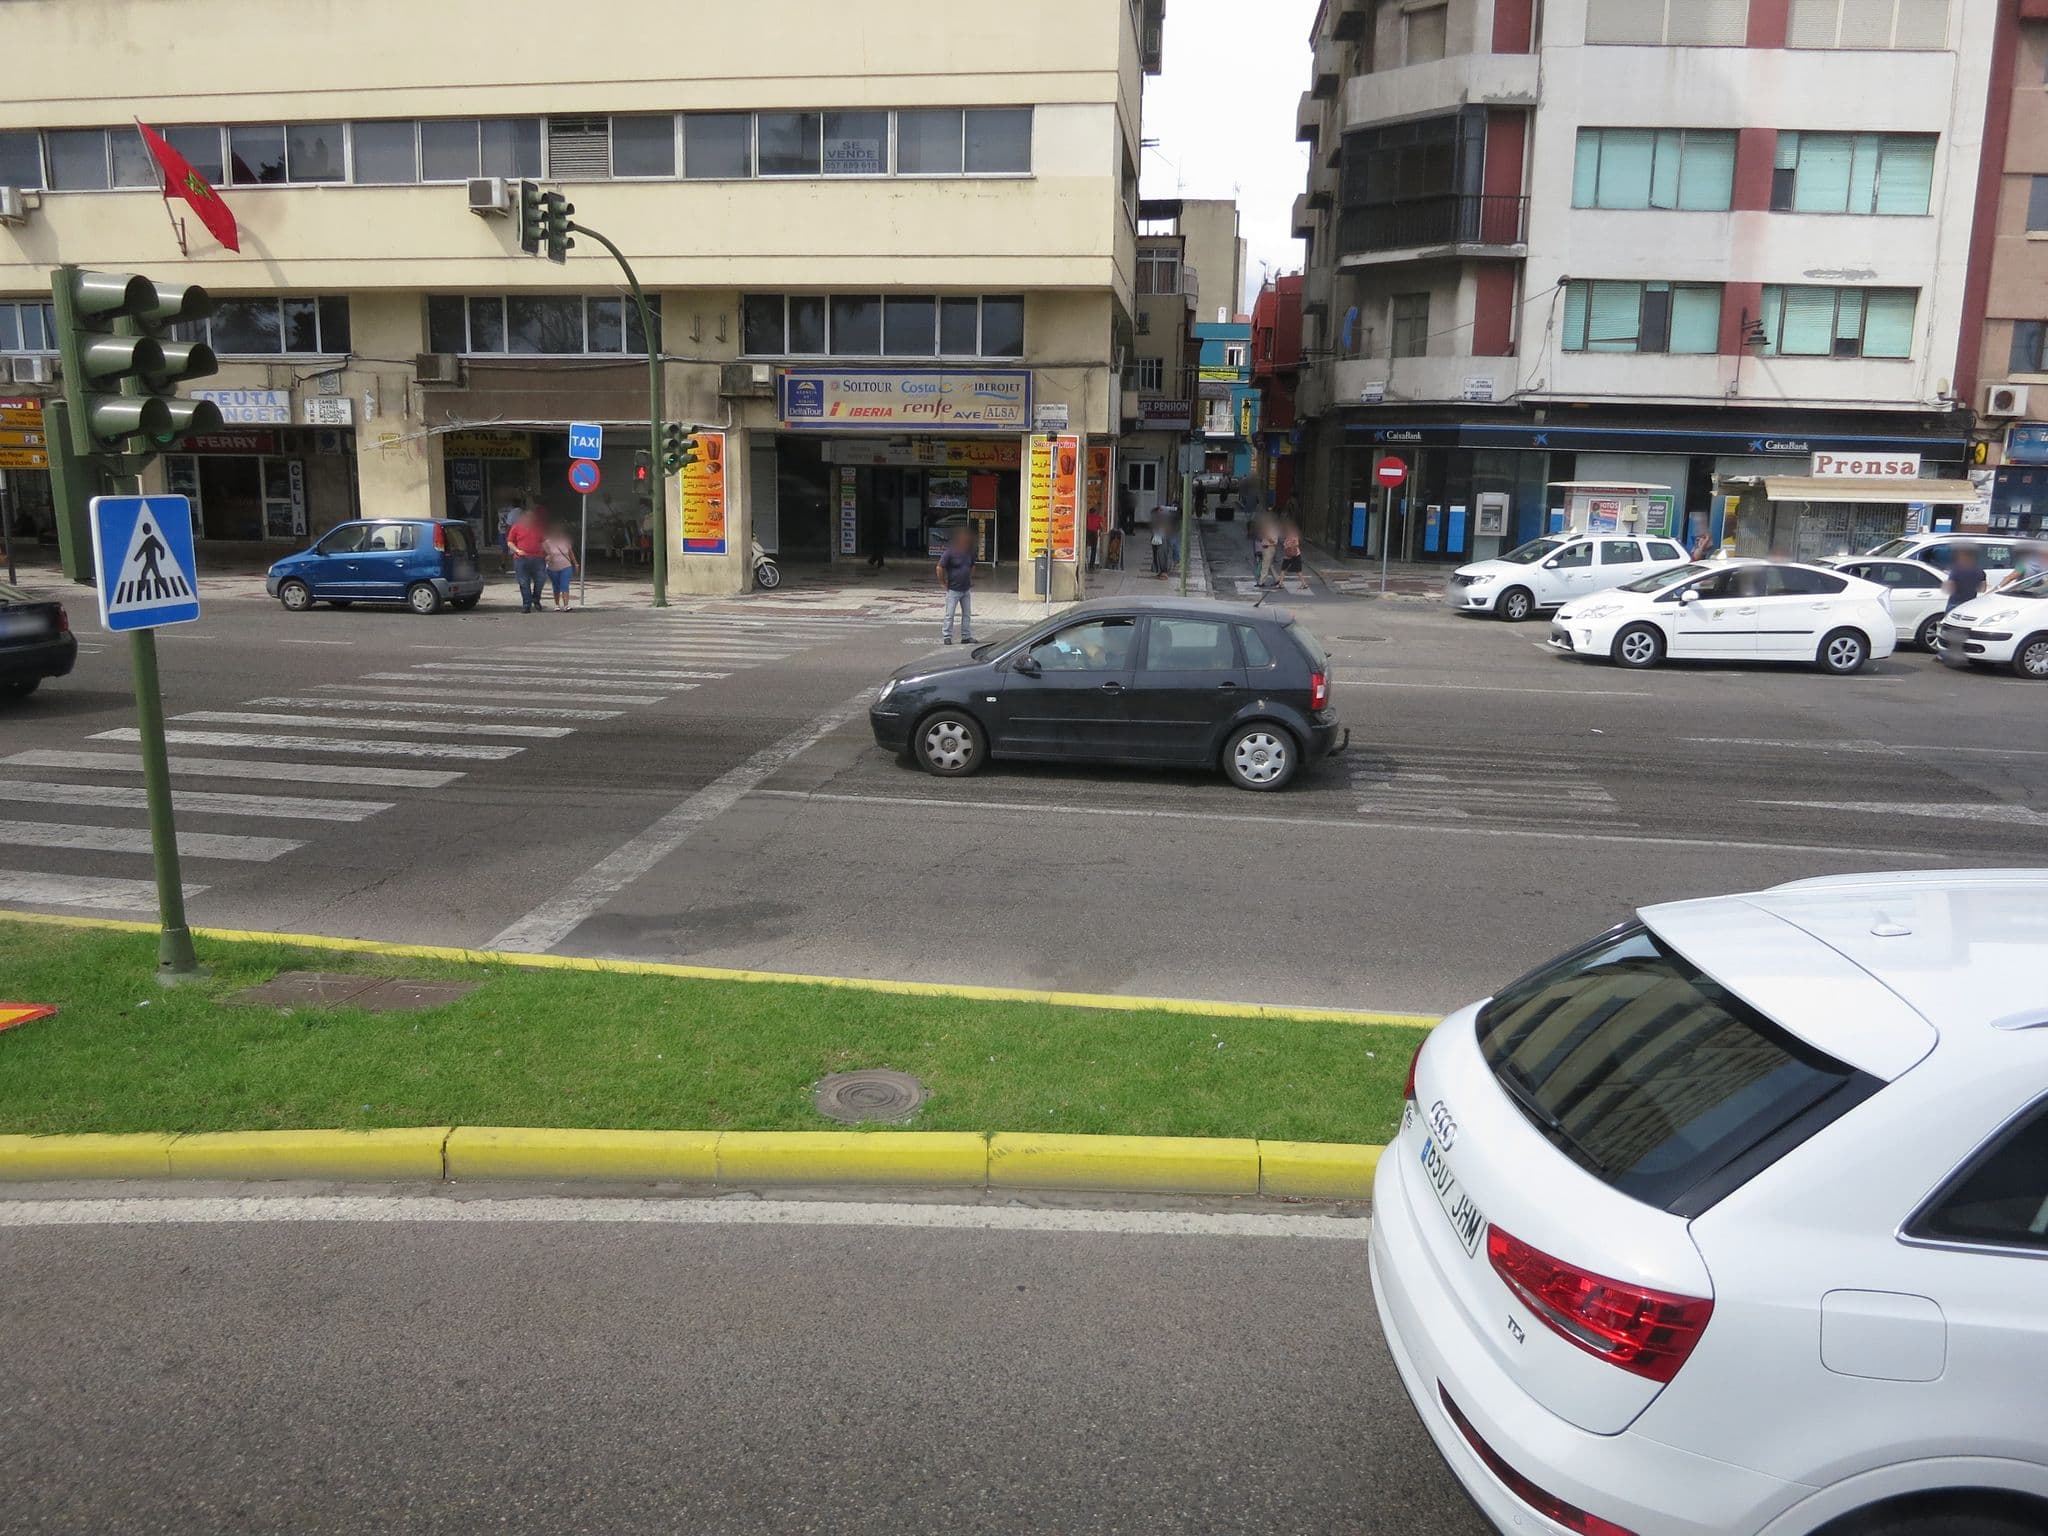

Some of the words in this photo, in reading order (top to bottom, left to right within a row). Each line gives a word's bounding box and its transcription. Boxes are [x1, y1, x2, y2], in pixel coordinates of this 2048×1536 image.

[827, 150, 876, 159] VENDE
[843, 379, 892, 393] SOLTOUR
[901, 381, 936, 393] Costa
[974, 382, 1020, 393] IBEROJET
[203, 391, 277, 406] CEUTA
[903, 398, 953, 419] renfe
[1153, 401, 1189, 411] PENSION
[223, 408, 287, 422] NGER
[849, 407, 893, 417] IBERIA
[953, 411, 981, 419] AVE
[986, 407, 1015, 417] ALSA
[1386, 430, 1422, 440] CaixaBank
[195, 436, 258, 448] FERRY
[572, 436, 599, 448] TAXI
[1765, 440, 1808, 450] CaixaBank
[1815, 455, 1916, 475] Prensa
